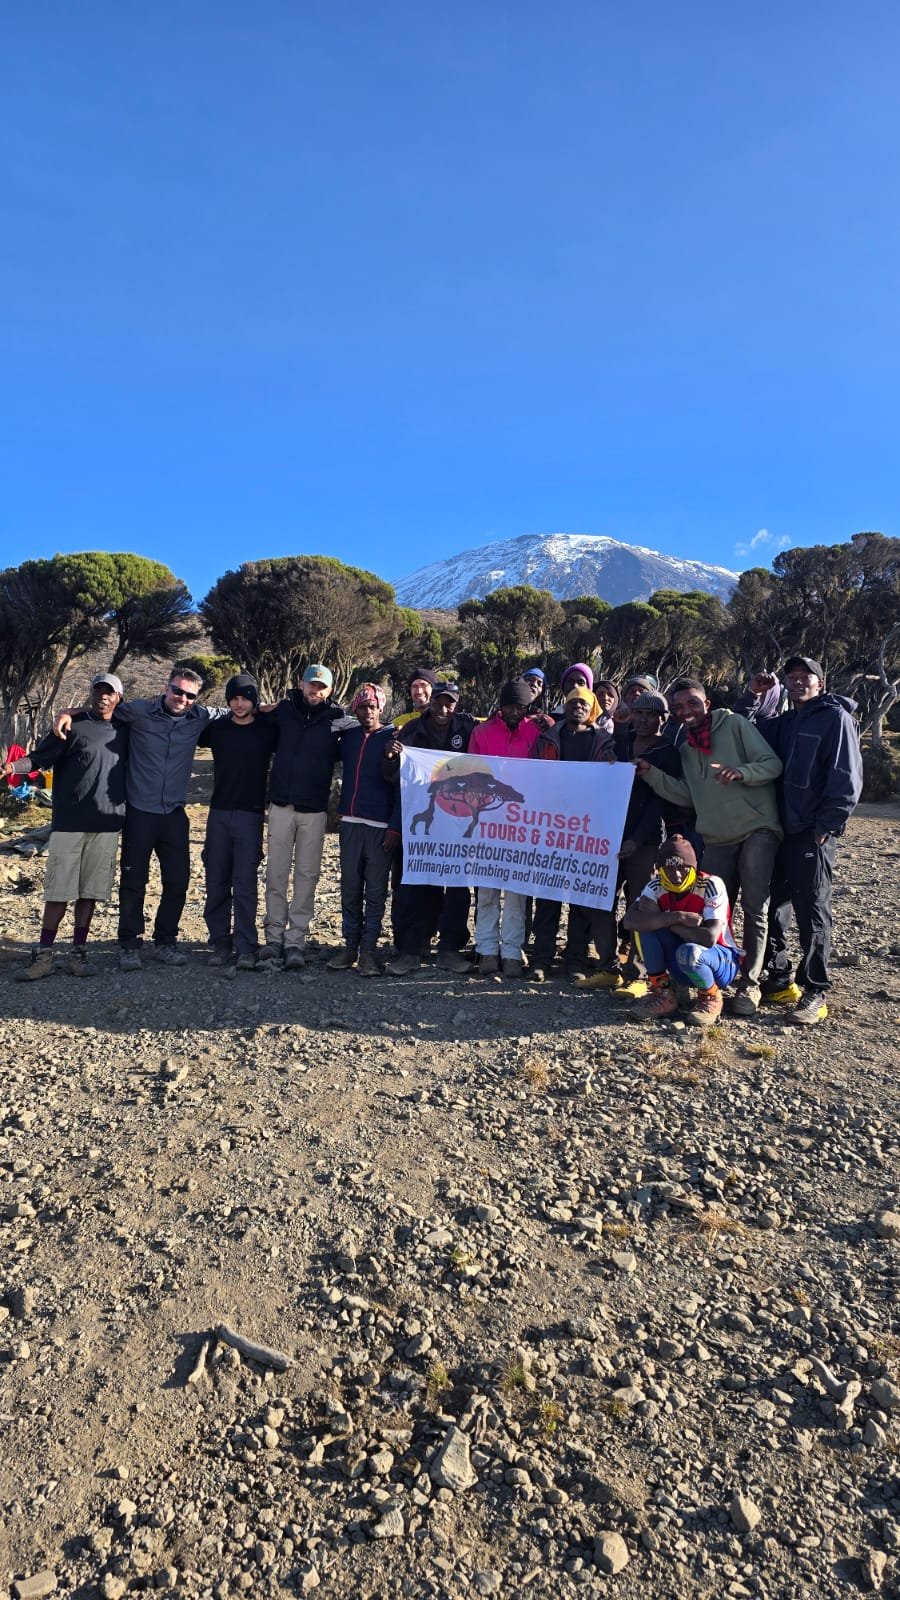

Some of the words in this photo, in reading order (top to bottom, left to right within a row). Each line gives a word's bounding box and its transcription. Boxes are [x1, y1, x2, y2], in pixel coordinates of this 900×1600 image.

[506, 802, 591, 833] Sunset
[480, 821, 528, 843] TOURS
[530, 830, 541, 845] &
[546, 831, 610, 856] SAFARIS
[407, 859, 461, 876] Kilimanjaro
[463, 862, 510, 882] Climbing
[512, 869, 531, 883] and
[532, 871, 571, 890] Wildlife
[573, 878, 609, 897] Safaris
[408, 841, 609, 880] www.sunsettoursandsafaris.com
